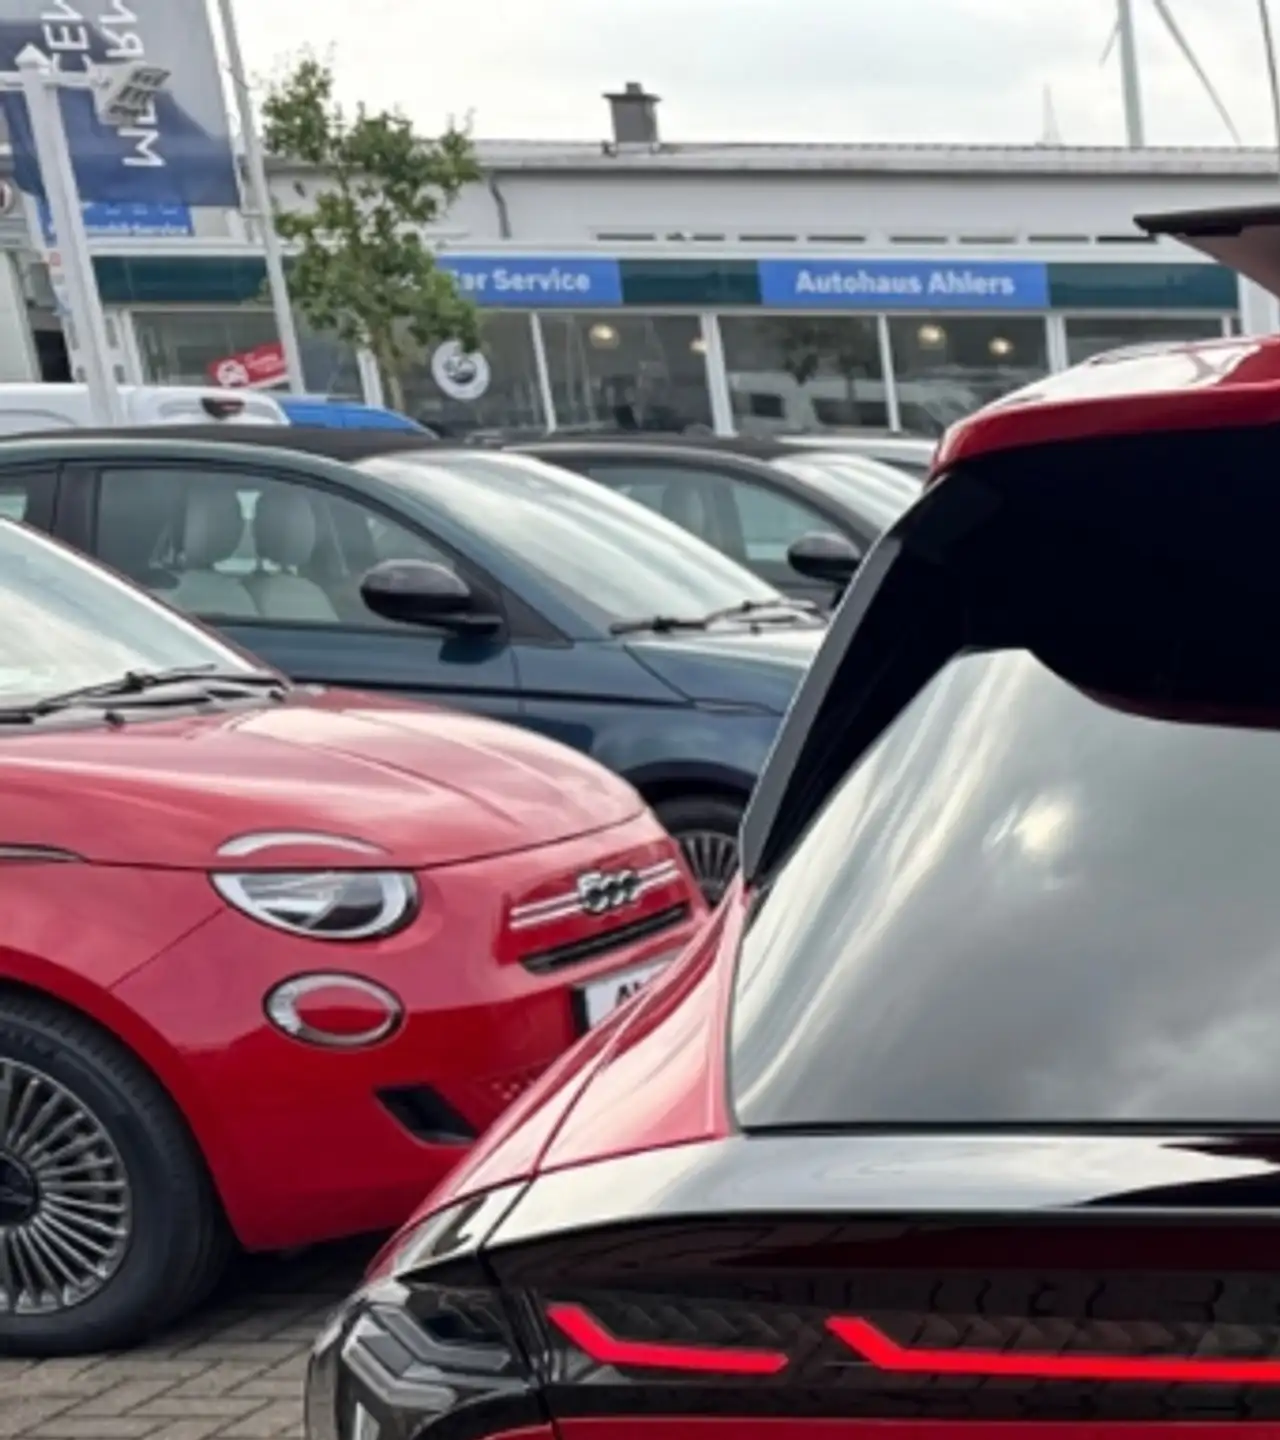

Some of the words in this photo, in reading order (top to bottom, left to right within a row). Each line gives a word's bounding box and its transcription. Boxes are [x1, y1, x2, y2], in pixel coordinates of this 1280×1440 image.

[492, 266, 592, 292] Service
[795, 268, 922, 295] Autohaus
[927, 269, 1016, 296] Ahlers
